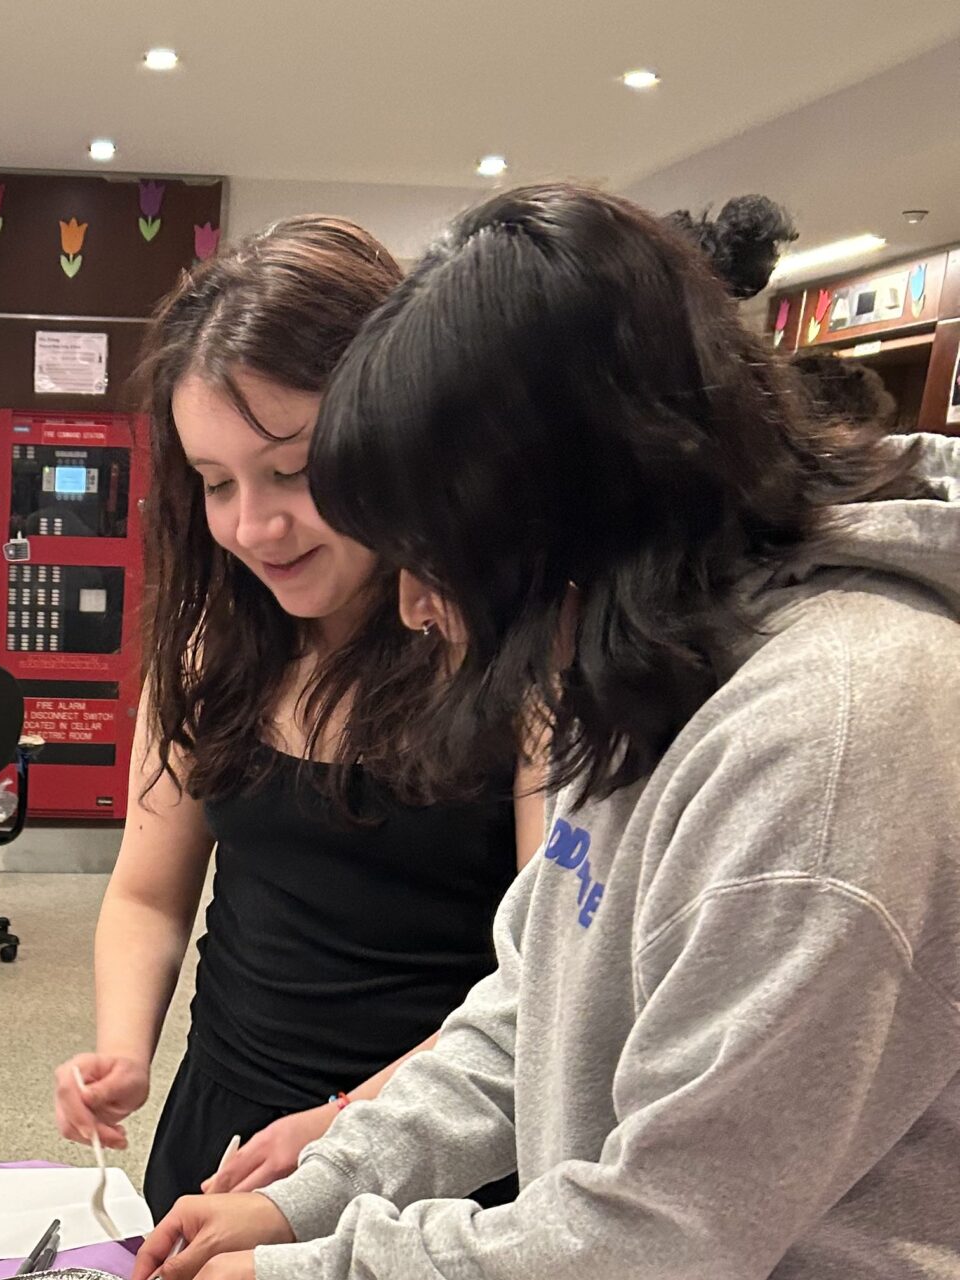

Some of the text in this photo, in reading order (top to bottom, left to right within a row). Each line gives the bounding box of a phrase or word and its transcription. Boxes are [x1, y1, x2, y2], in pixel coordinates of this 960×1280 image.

[35, 701, 86, 711] FIRE ALARM
[30, 711, 79, 721] DISCONNECT
[82, 712, 114, 721] SWITCH
[23, 721, 102, 731] OCATED IN CELLAR
[68, 732, 93, 740] ROOM
